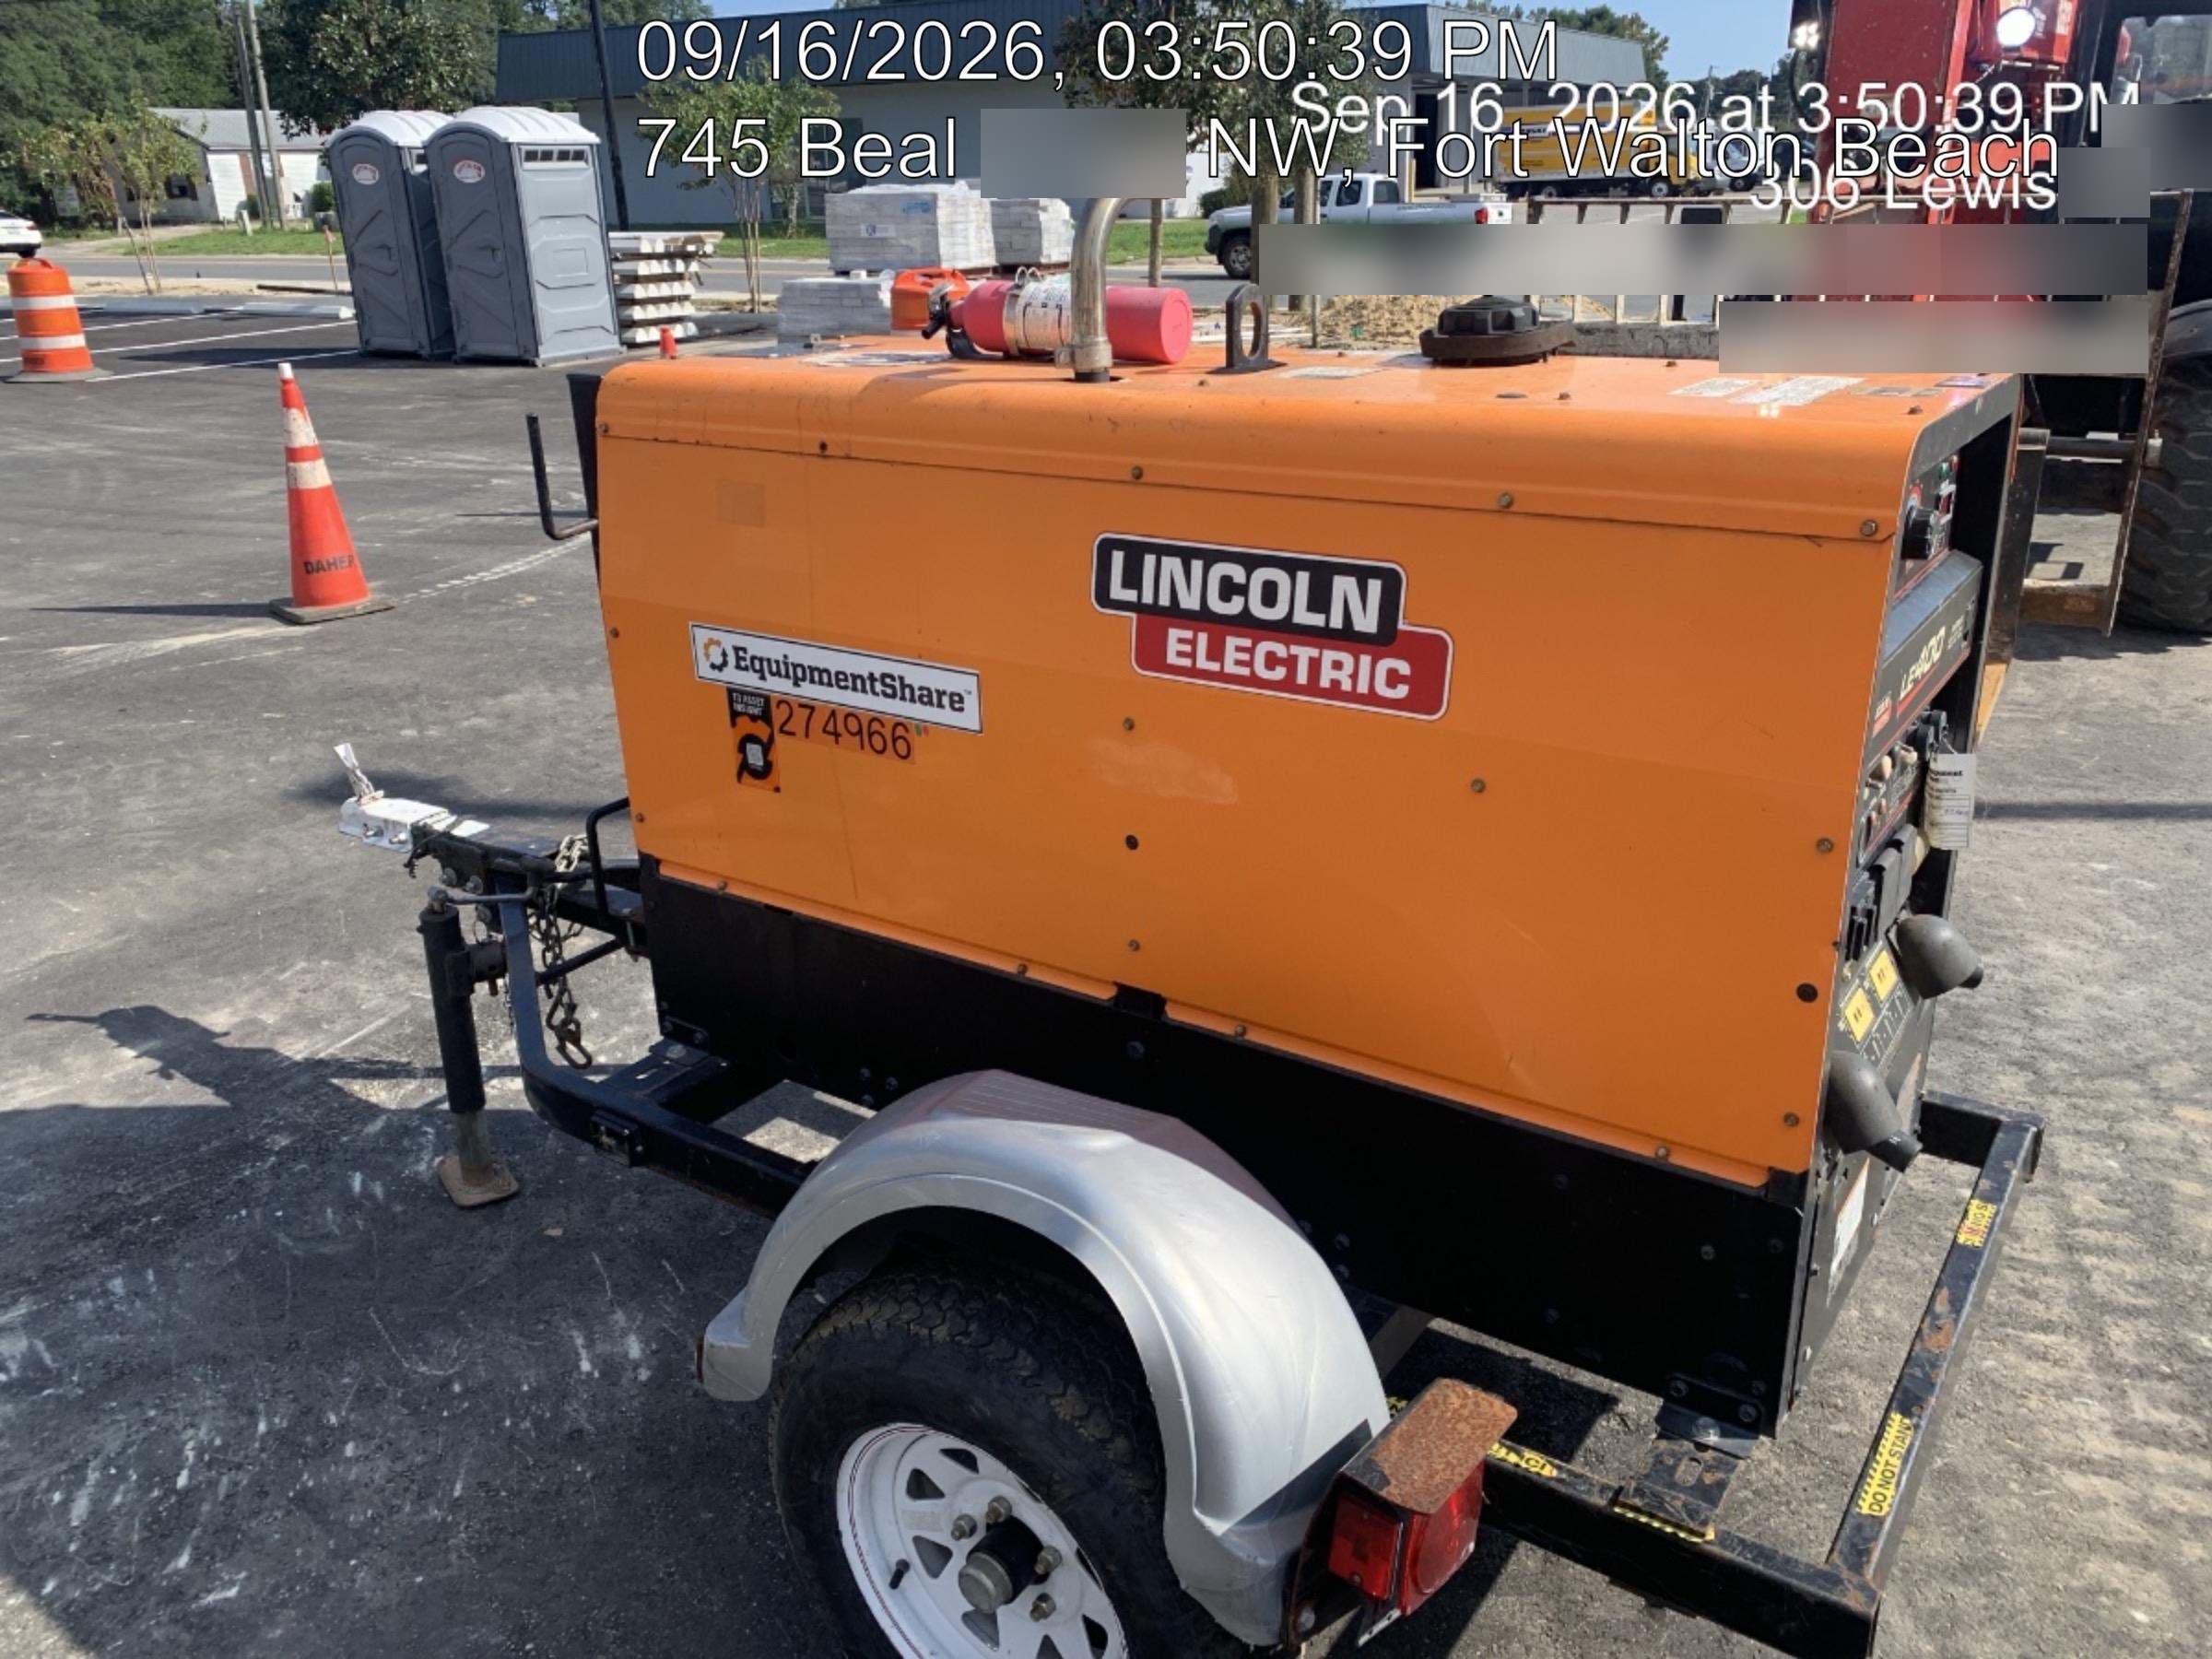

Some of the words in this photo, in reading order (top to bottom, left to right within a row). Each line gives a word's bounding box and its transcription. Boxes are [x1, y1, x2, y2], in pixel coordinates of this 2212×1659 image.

[1109, 549, 1382, 635] LINCOLN
[731, 644, 966, 713] EquipmentShare
[1166, 627, 1412, 700] ELECTRIC
[775, 700, 912, 760] 274966
[1868, 1491, 1888, 1513] DO
[1877, 1459, 1898, 1491] NOT
